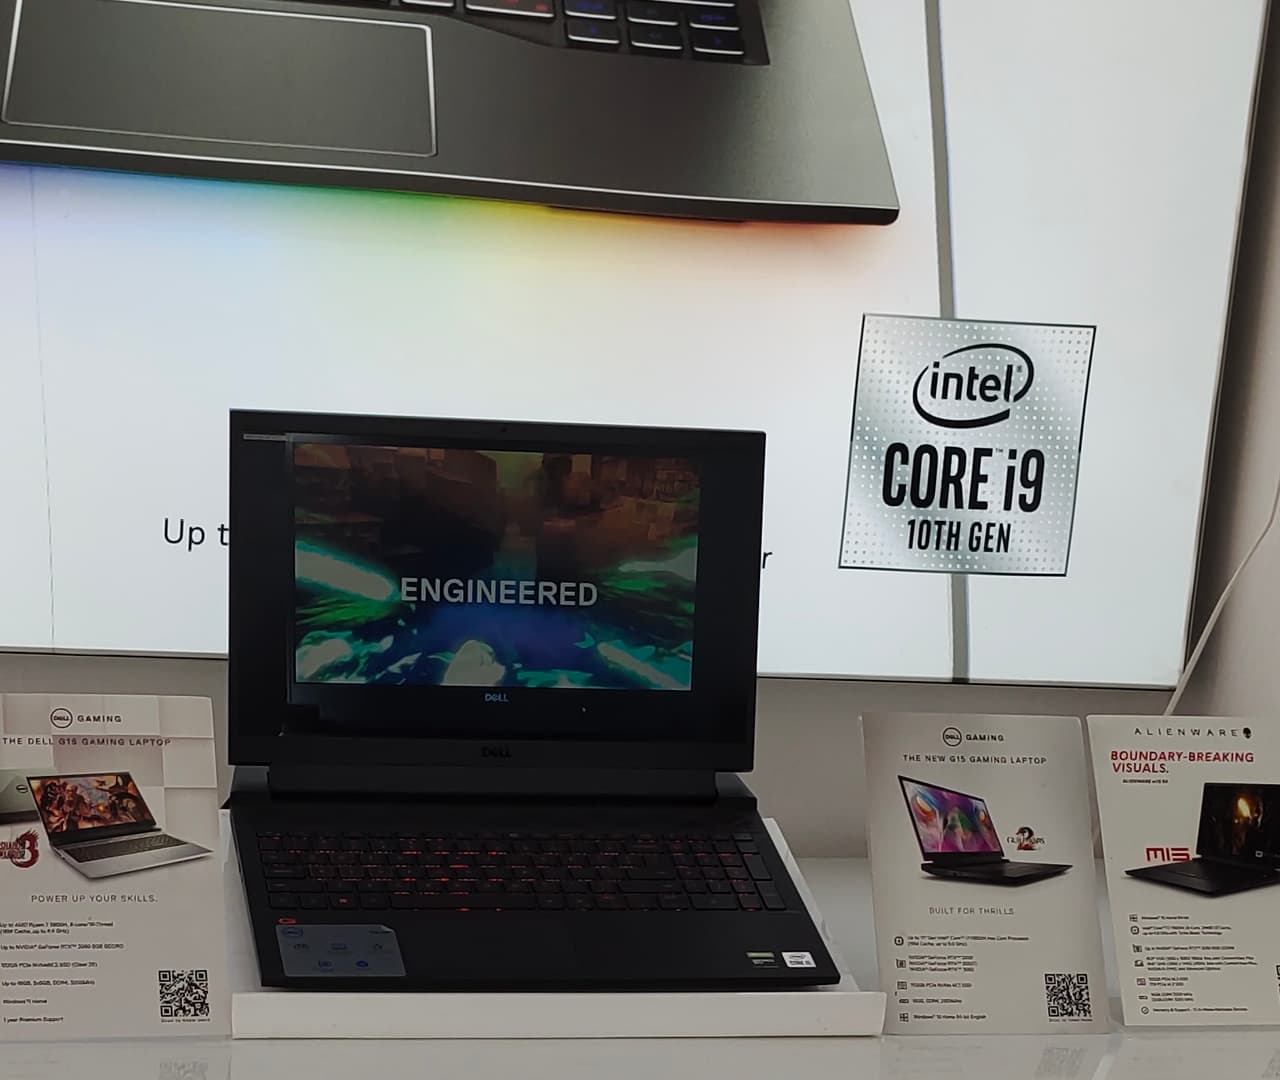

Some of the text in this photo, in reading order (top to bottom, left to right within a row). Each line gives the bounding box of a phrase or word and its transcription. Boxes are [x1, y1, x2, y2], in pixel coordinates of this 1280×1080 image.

[1003, 449, 1045, 512] i9
[164, 517, 205, 552] Up
[907, 519, 1011, 553] 10TH GEN
[400, 577, 598, 606] ENGINEERED
[484, 692, 510, 702] DELL
[77, 714, 122, 723] GAMING
[1134, 728, 1238, 737] ALIENWARE
[2, 737, 24, 745] THE
[27, 738, 54, 746] DELL
[82, 738, 125, 747] GAMING
[129, 739, 171, 747] LAPTOP
[966, 734, 1004, 742] GAMING
[903, 754, 1047, 765] THE NEW G15 GAMING LAPTOP
[1110, 750, 1254, 763] BOUNDARY-BREAKING
[1112, 762, 1169, 774] VISUALS.
[31, 894, 68, 903] POWER
[72, 894, 86, 903] UP
[89, 895, 117, 903] YOUR
[929, 907, 1014, 915] BUILT FOR THRILLS
